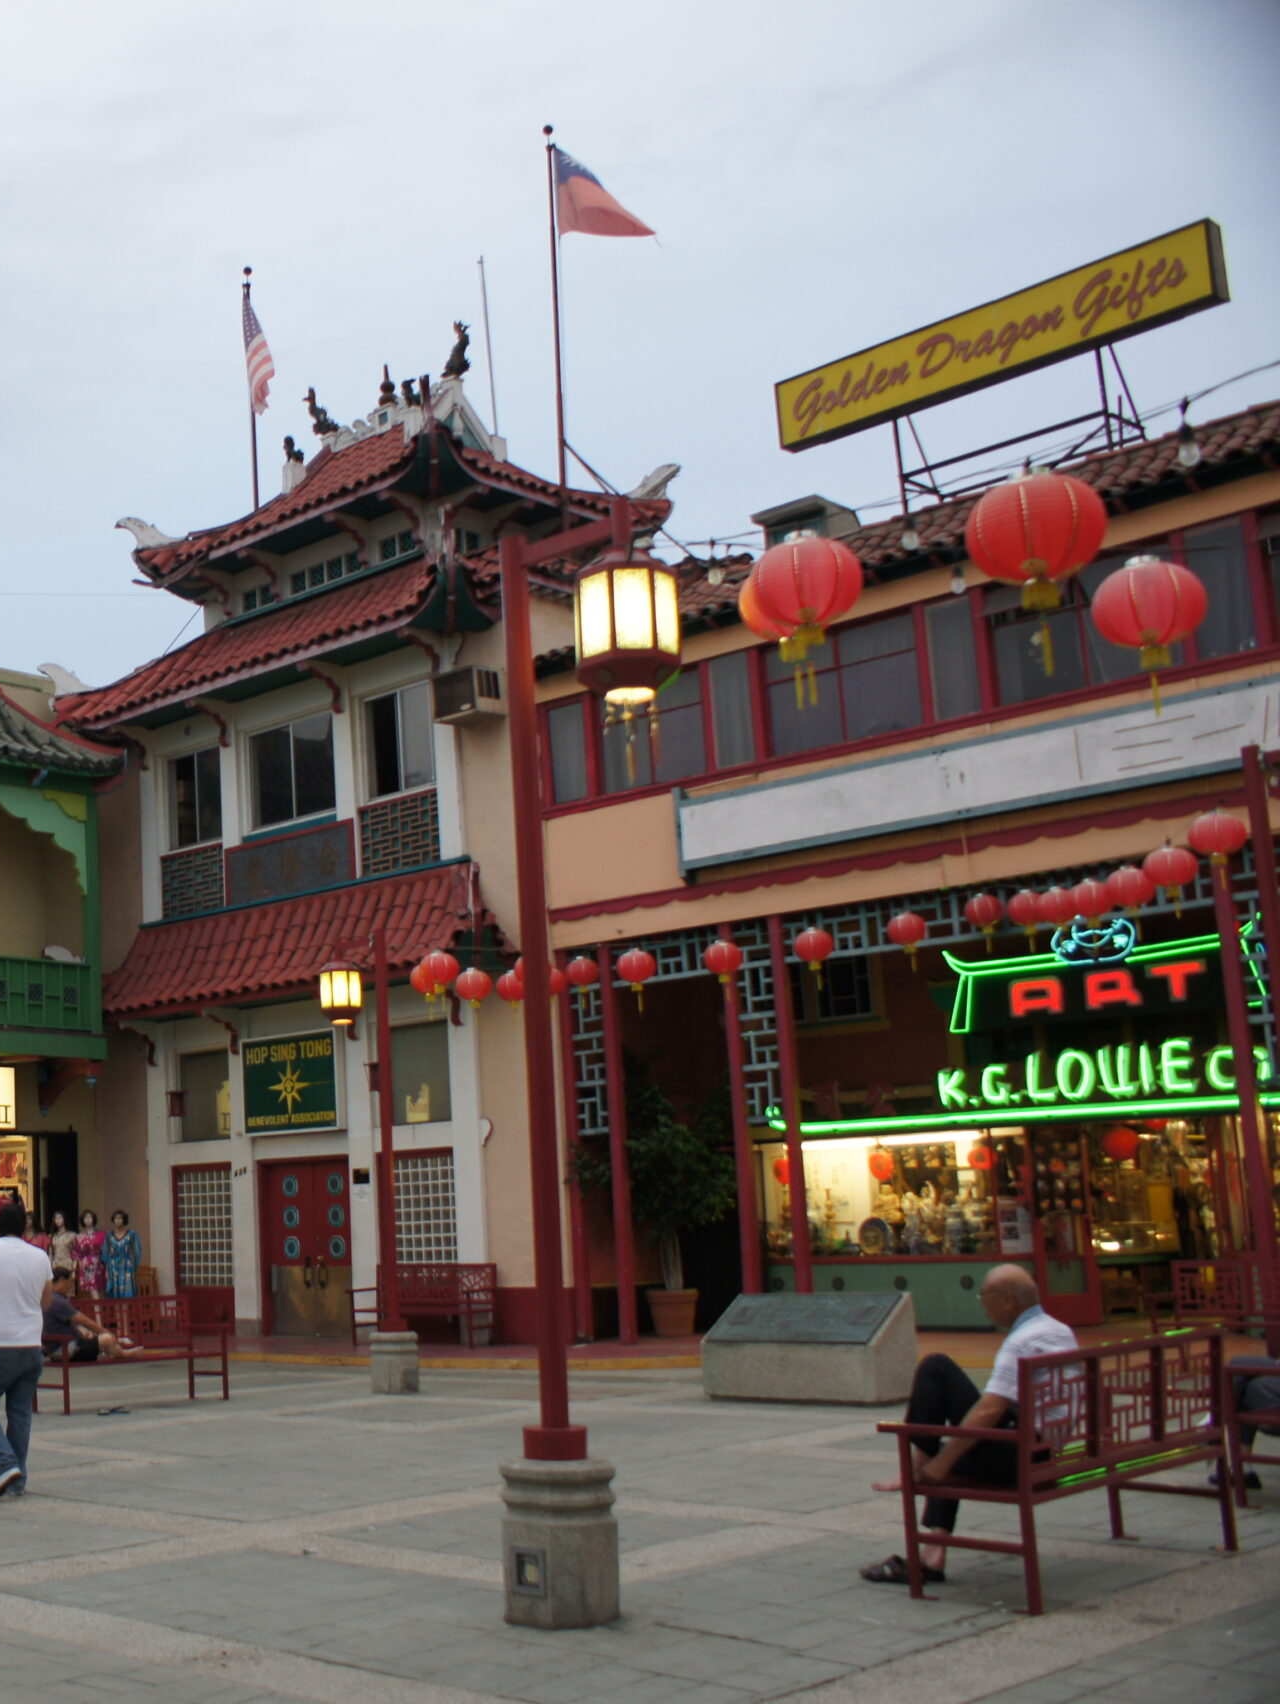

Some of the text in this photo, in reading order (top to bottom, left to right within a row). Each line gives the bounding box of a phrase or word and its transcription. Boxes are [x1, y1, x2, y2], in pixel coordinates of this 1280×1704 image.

[792, 257, 1188, 436] Golden Dragon Gifts
[1008, 958, 1206, 1017] ART
[246, 1038, 332, 1065] HOP SING TONG
[247, 1110, 336, 1127] BENEVOLENT ASSOCIATION
